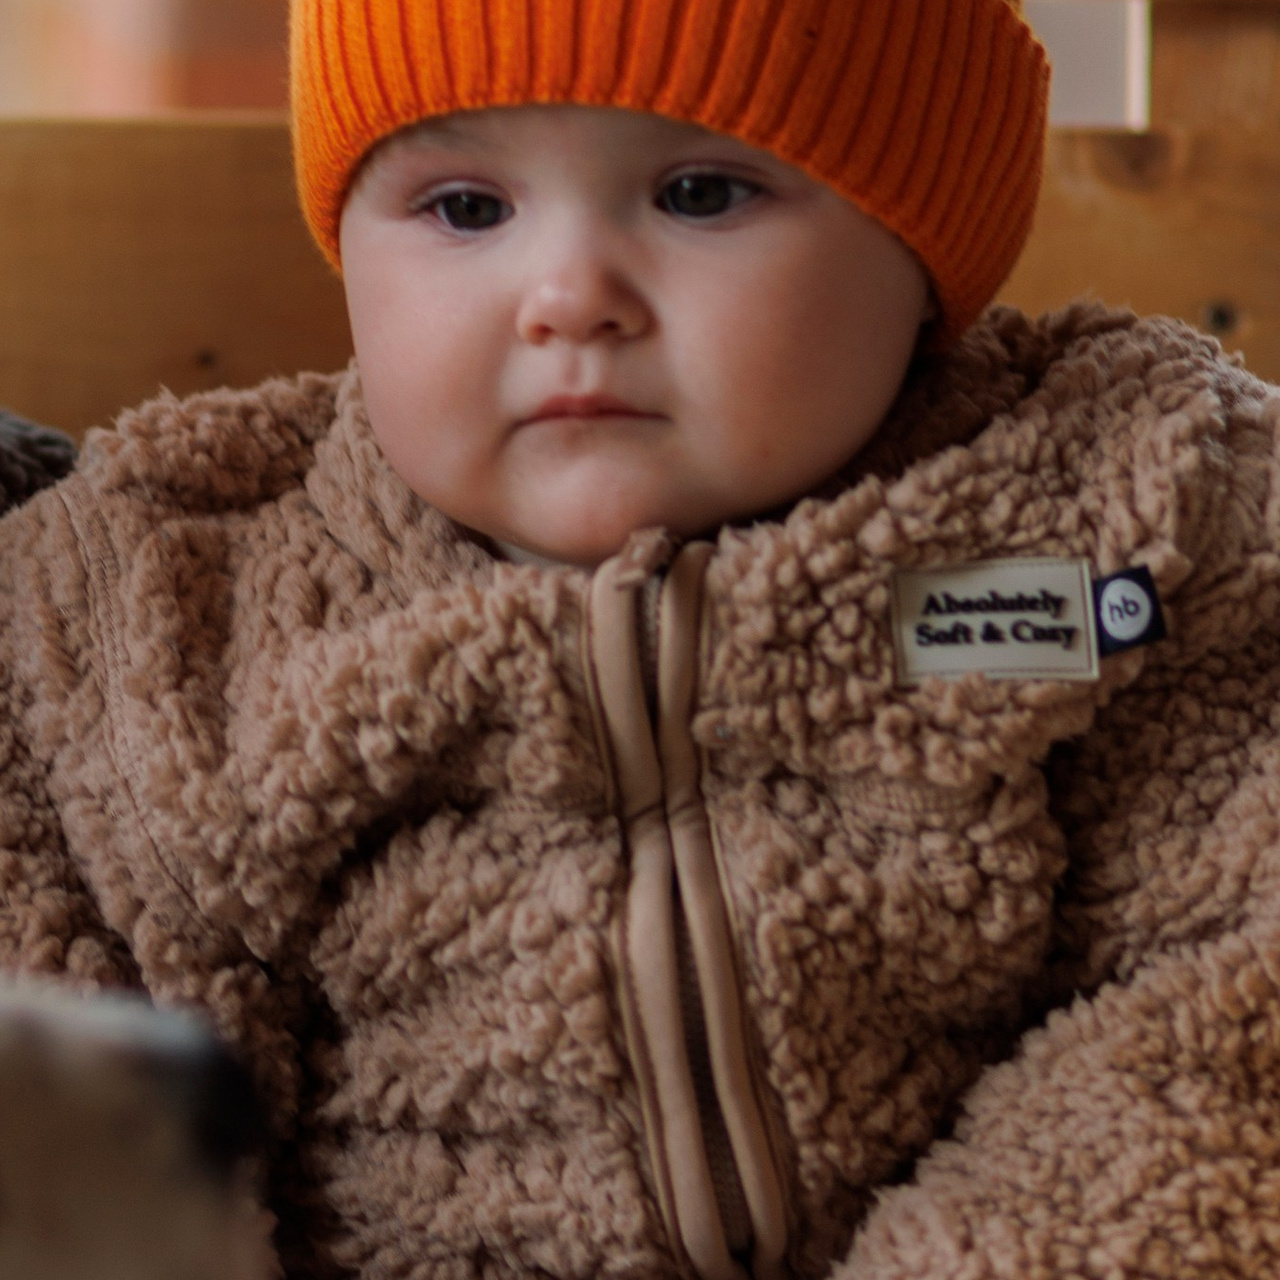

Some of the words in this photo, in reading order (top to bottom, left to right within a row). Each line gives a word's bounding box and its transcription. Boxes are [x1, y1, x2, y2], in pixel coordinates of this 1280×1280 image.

[922, 588, 1067, 619] Absolutely
[916, 620, 973, 646] Soft
[981, 619, 1006, 644] &
[1010, 619, 1078, 651] Cozy
